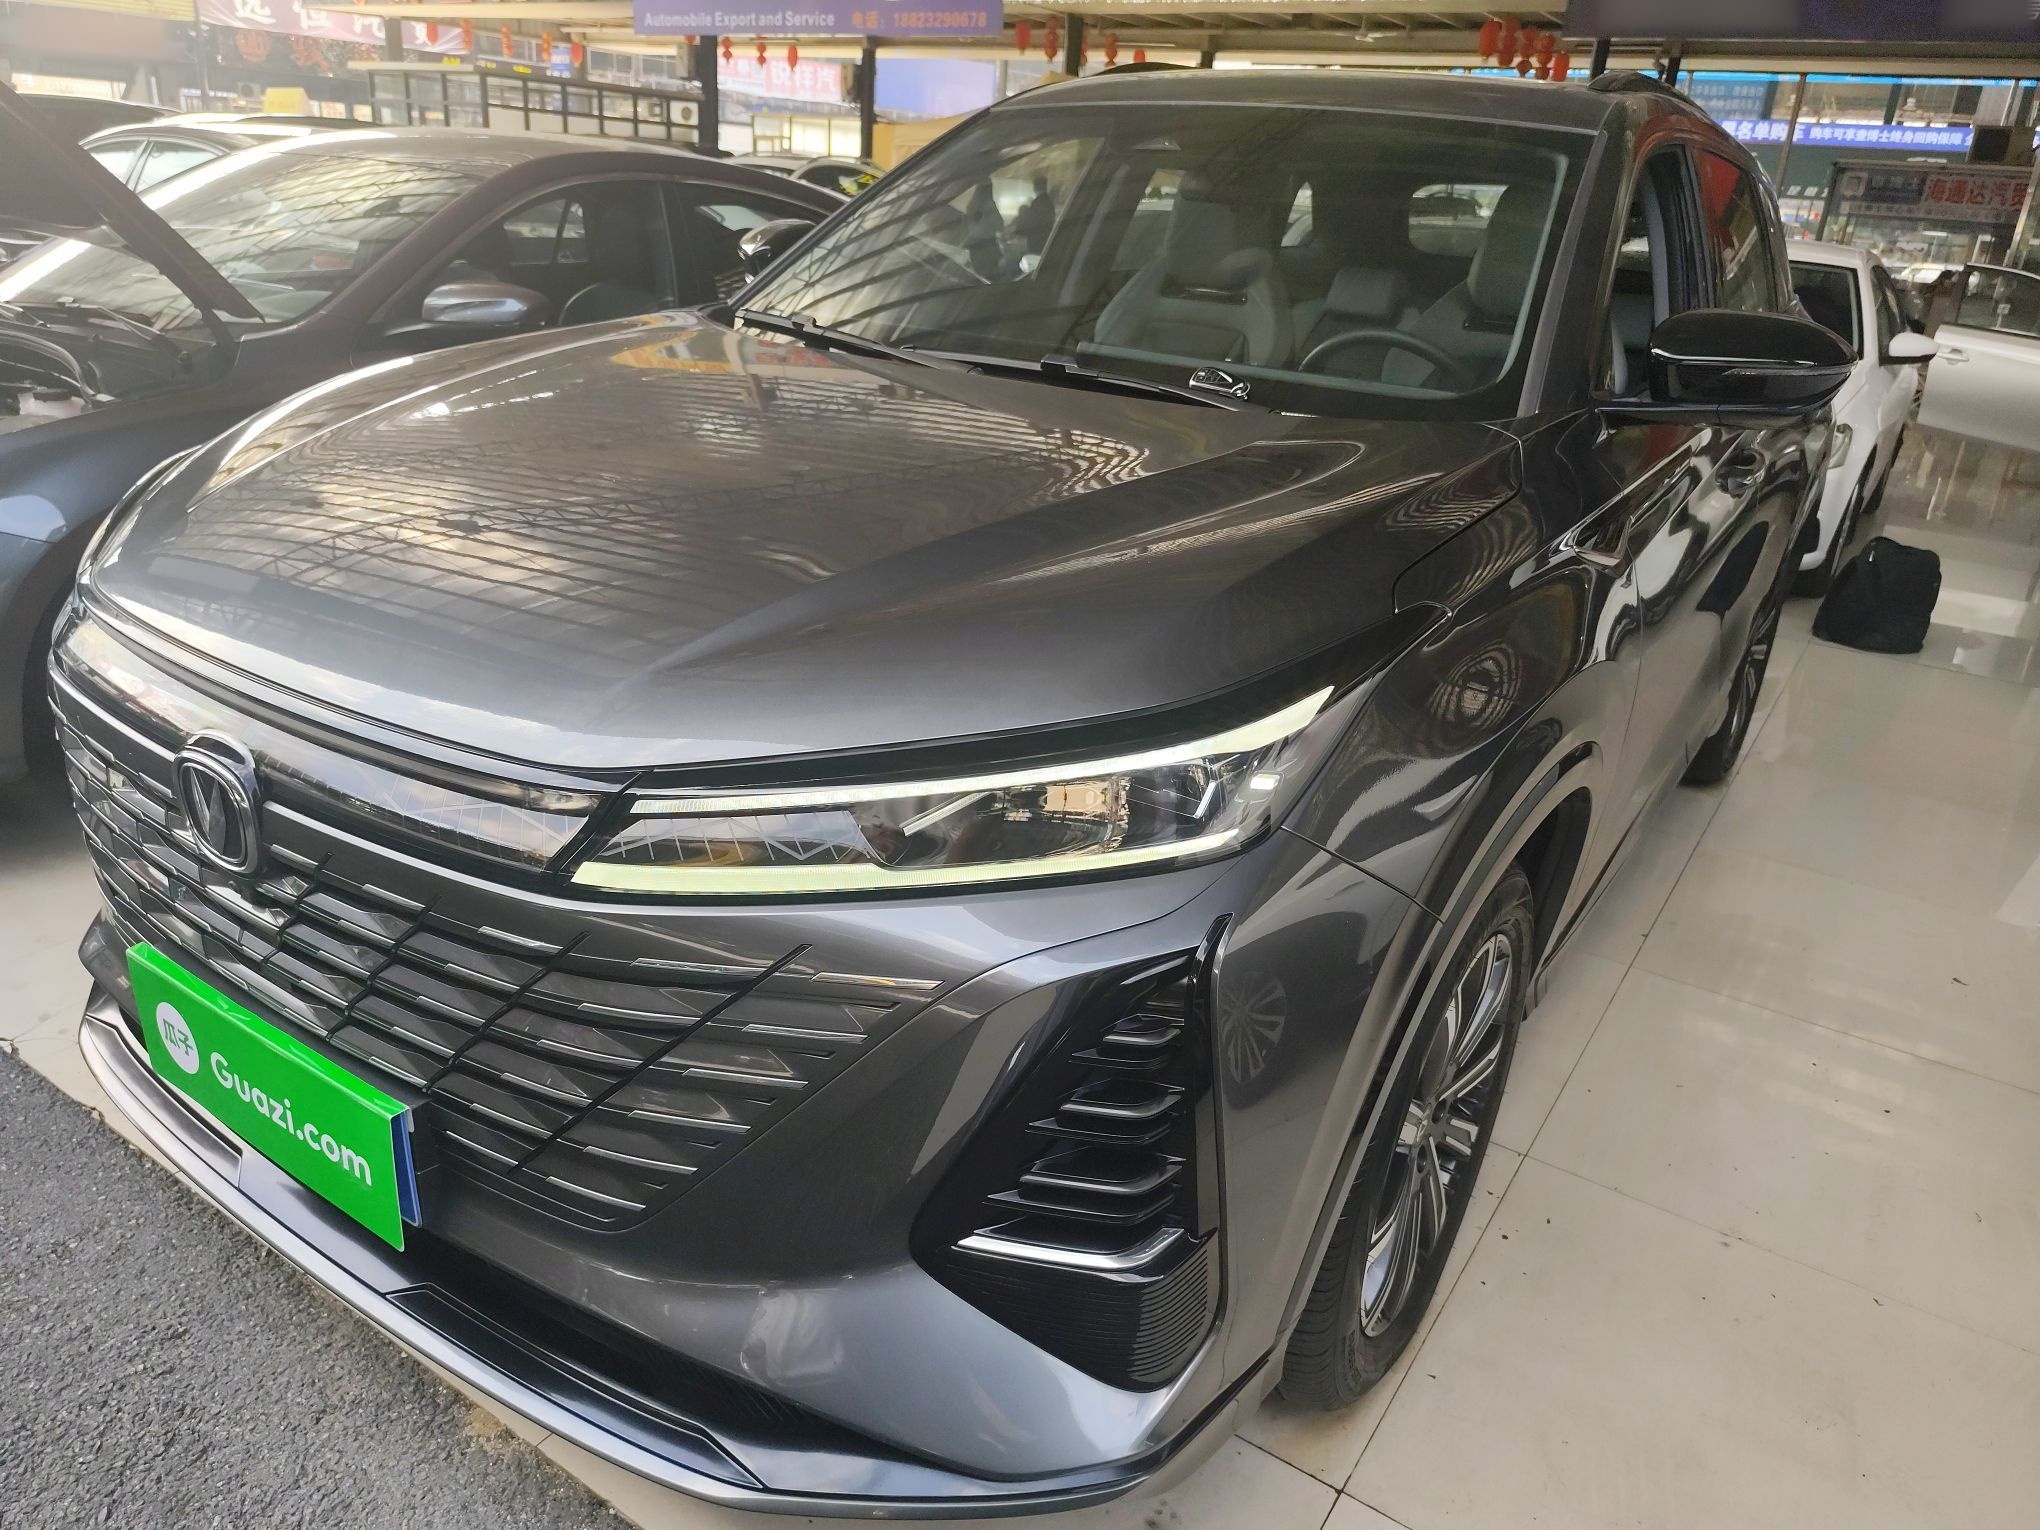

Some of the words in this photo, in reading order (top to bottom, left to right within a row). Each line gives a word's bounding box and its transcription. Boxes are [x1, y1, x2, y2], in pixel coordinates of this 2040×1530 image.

[645, 12, 712, 27] Automobile
[715, 12, 756, 29] Export
[759, 11, 782, 26] and
[785, 11, 835, 26] Service
[162, 1017, 193, 1056] 瓜子
[210, 1051, 373, 1186] Guazi.com
